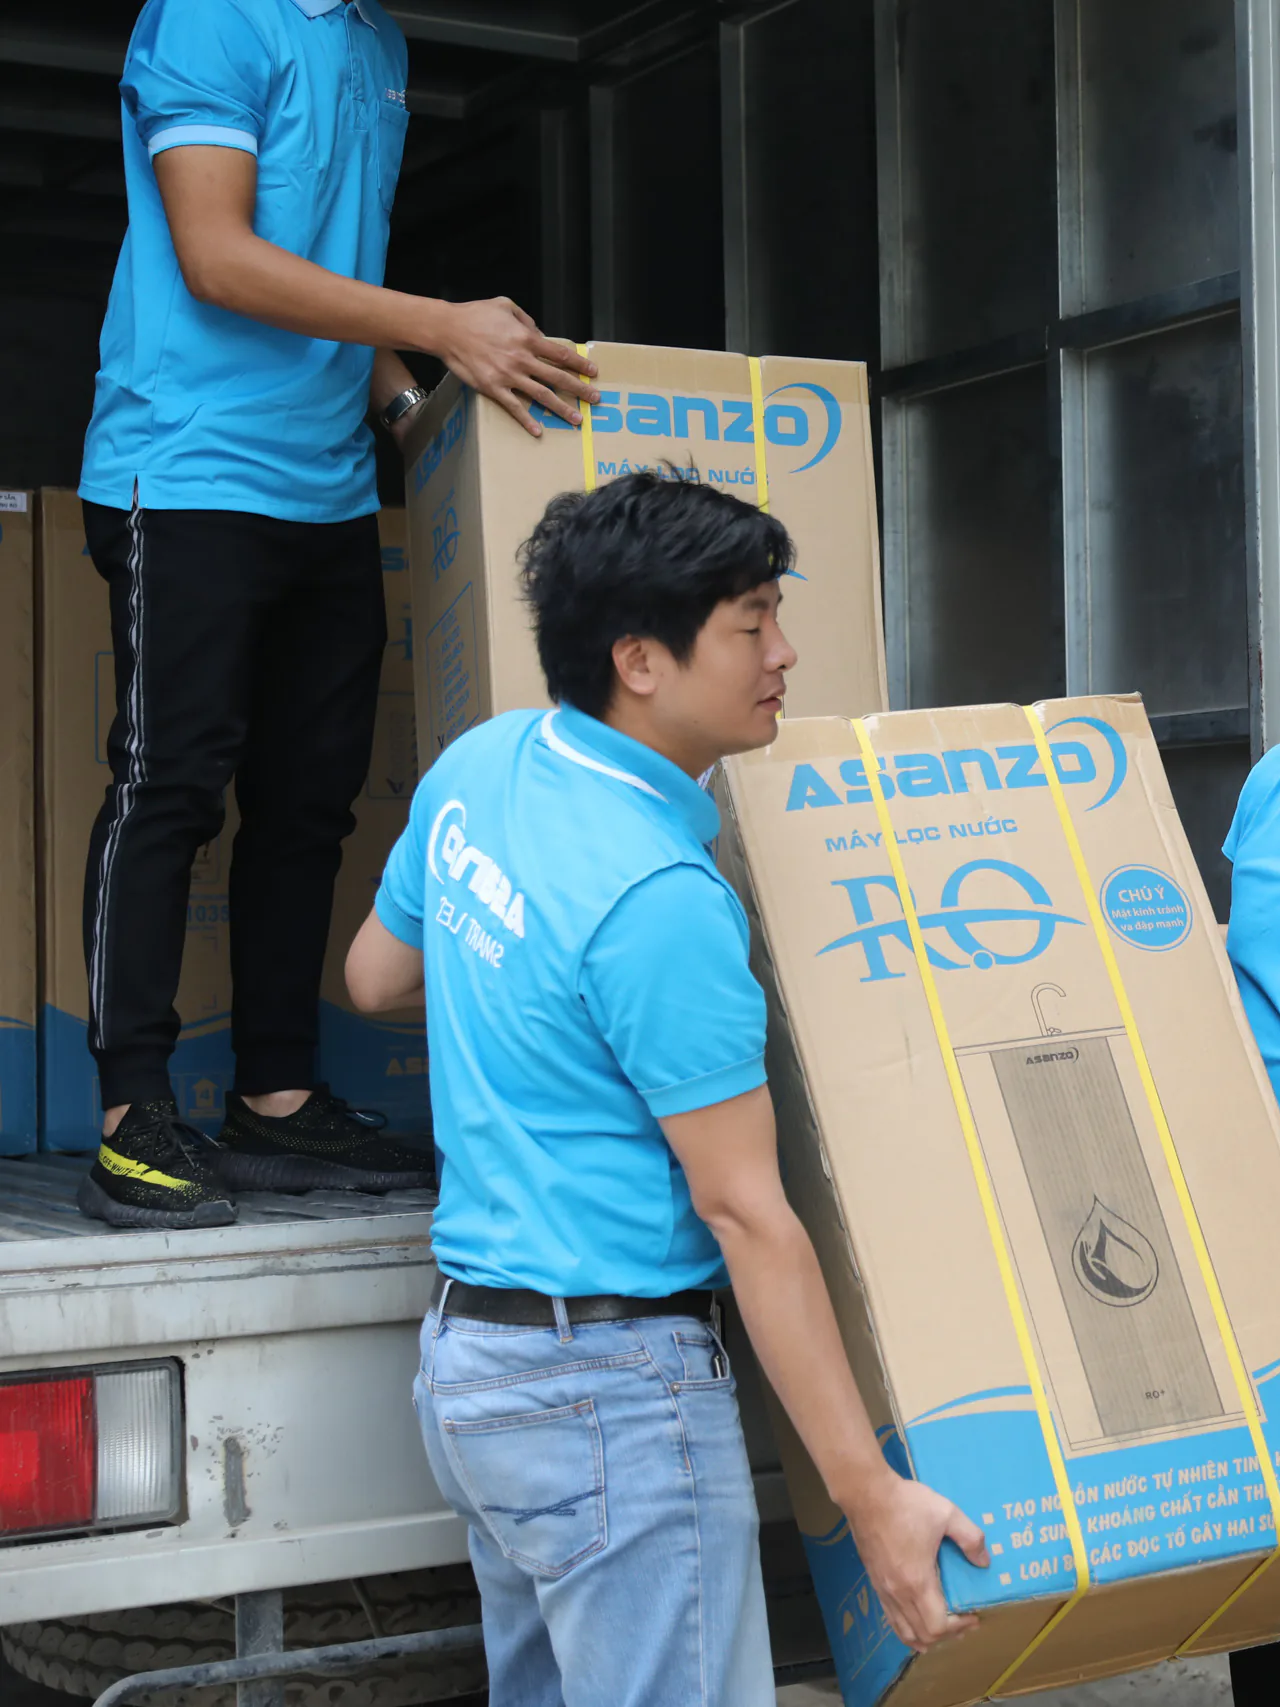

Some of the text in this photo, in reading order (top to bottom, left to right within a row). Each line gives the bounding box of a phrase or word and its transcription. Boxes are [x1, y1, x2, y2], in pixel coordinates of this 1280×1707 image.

[785, 740, 1097, 811] Asanzo
[825, 816, 1018, 852] MÁY LỌC NƯỚC
[1118, 884, 1165, 902] CHÚ Ý
[1026, 1051, 1074, 1065] Asanzo
[1003, 1499, 1036, 1521] TẠO
[1042, 1482, 1099, 1513] NGỒN
[1104, 1474, 1148, 1500] NƯỚC
[1152, 1468, 1174, 1492] TỰ
[1178, 1460, 1228, 1485] NHIÊN
[1233, 1456, 1261, 1474] TIN
[1011, 1522, 1034, 1549] BỔ
[1039, 1524, 1070, 1543] SUN
[1087, 1505, 1155, 1533] KHOÁNG
[1160, 1490, 1202, 1518] CHẤT
[1208, 1484, 1238, 1509] CẦN
[1020, 1557, 1058, 1580] LOẠI
[1090, 1541, 1122, 1565] CÁC
[1165, 1524, 1186, 1549] TỐ
[1191, 1521, 1222, 1544] GÂY
[1228, 1517, 1254, 1538] HẠI
